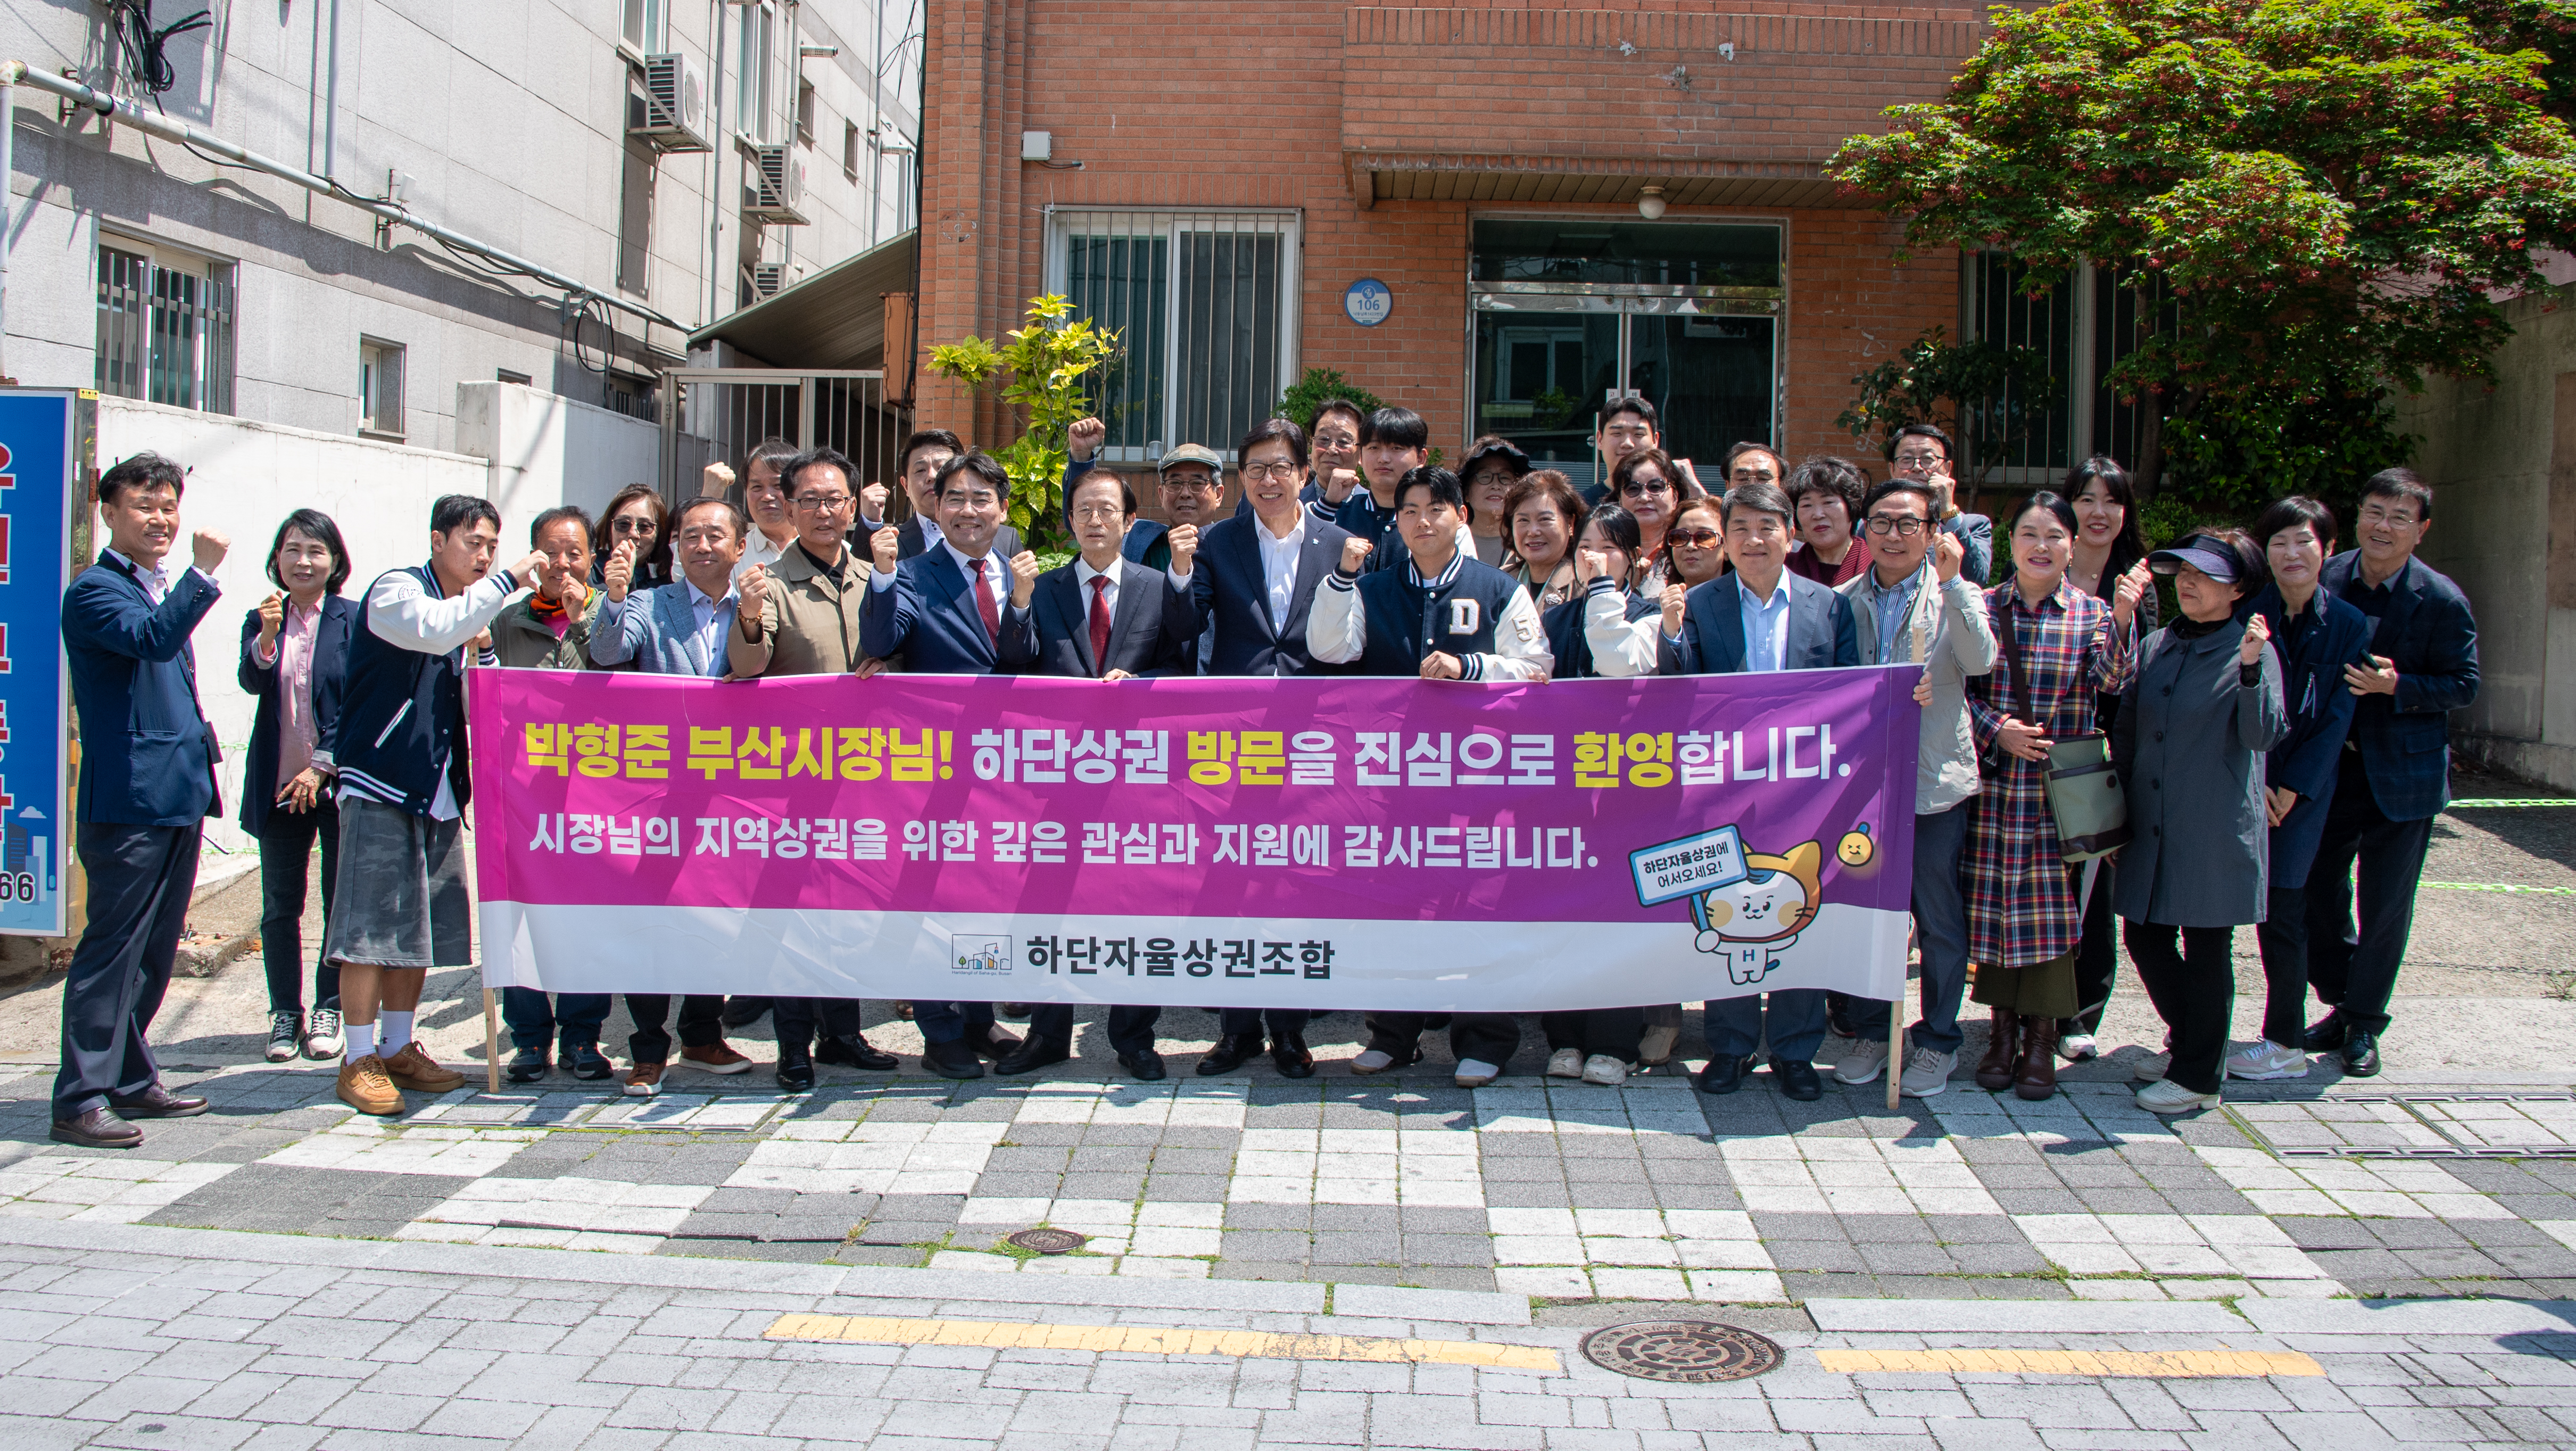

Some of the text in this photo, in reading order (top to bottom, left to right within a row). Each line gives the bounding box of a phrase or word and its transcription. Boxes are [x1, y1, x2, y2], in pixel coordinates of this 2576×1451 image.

[1357, 299, 1380, 310] 106
[1449, 598, 1480, 635] D
[526, 723, 1850, 787] 박형준 부산시장님! 하단상권 방문을 진심으로 환영합니다.
[530, 813, 1597, 869] 시장님의 지역상권을 위한 깊은 관심과 지원에 감사드립니다.
[1643, 842, 1729, 874] 하단자율상권에
[1658, 861, 1722, 887] 어서오세요!
[1027, 936, 1335, 979] 하단자율상권조합
[1743, 949, 1754, 962] H
